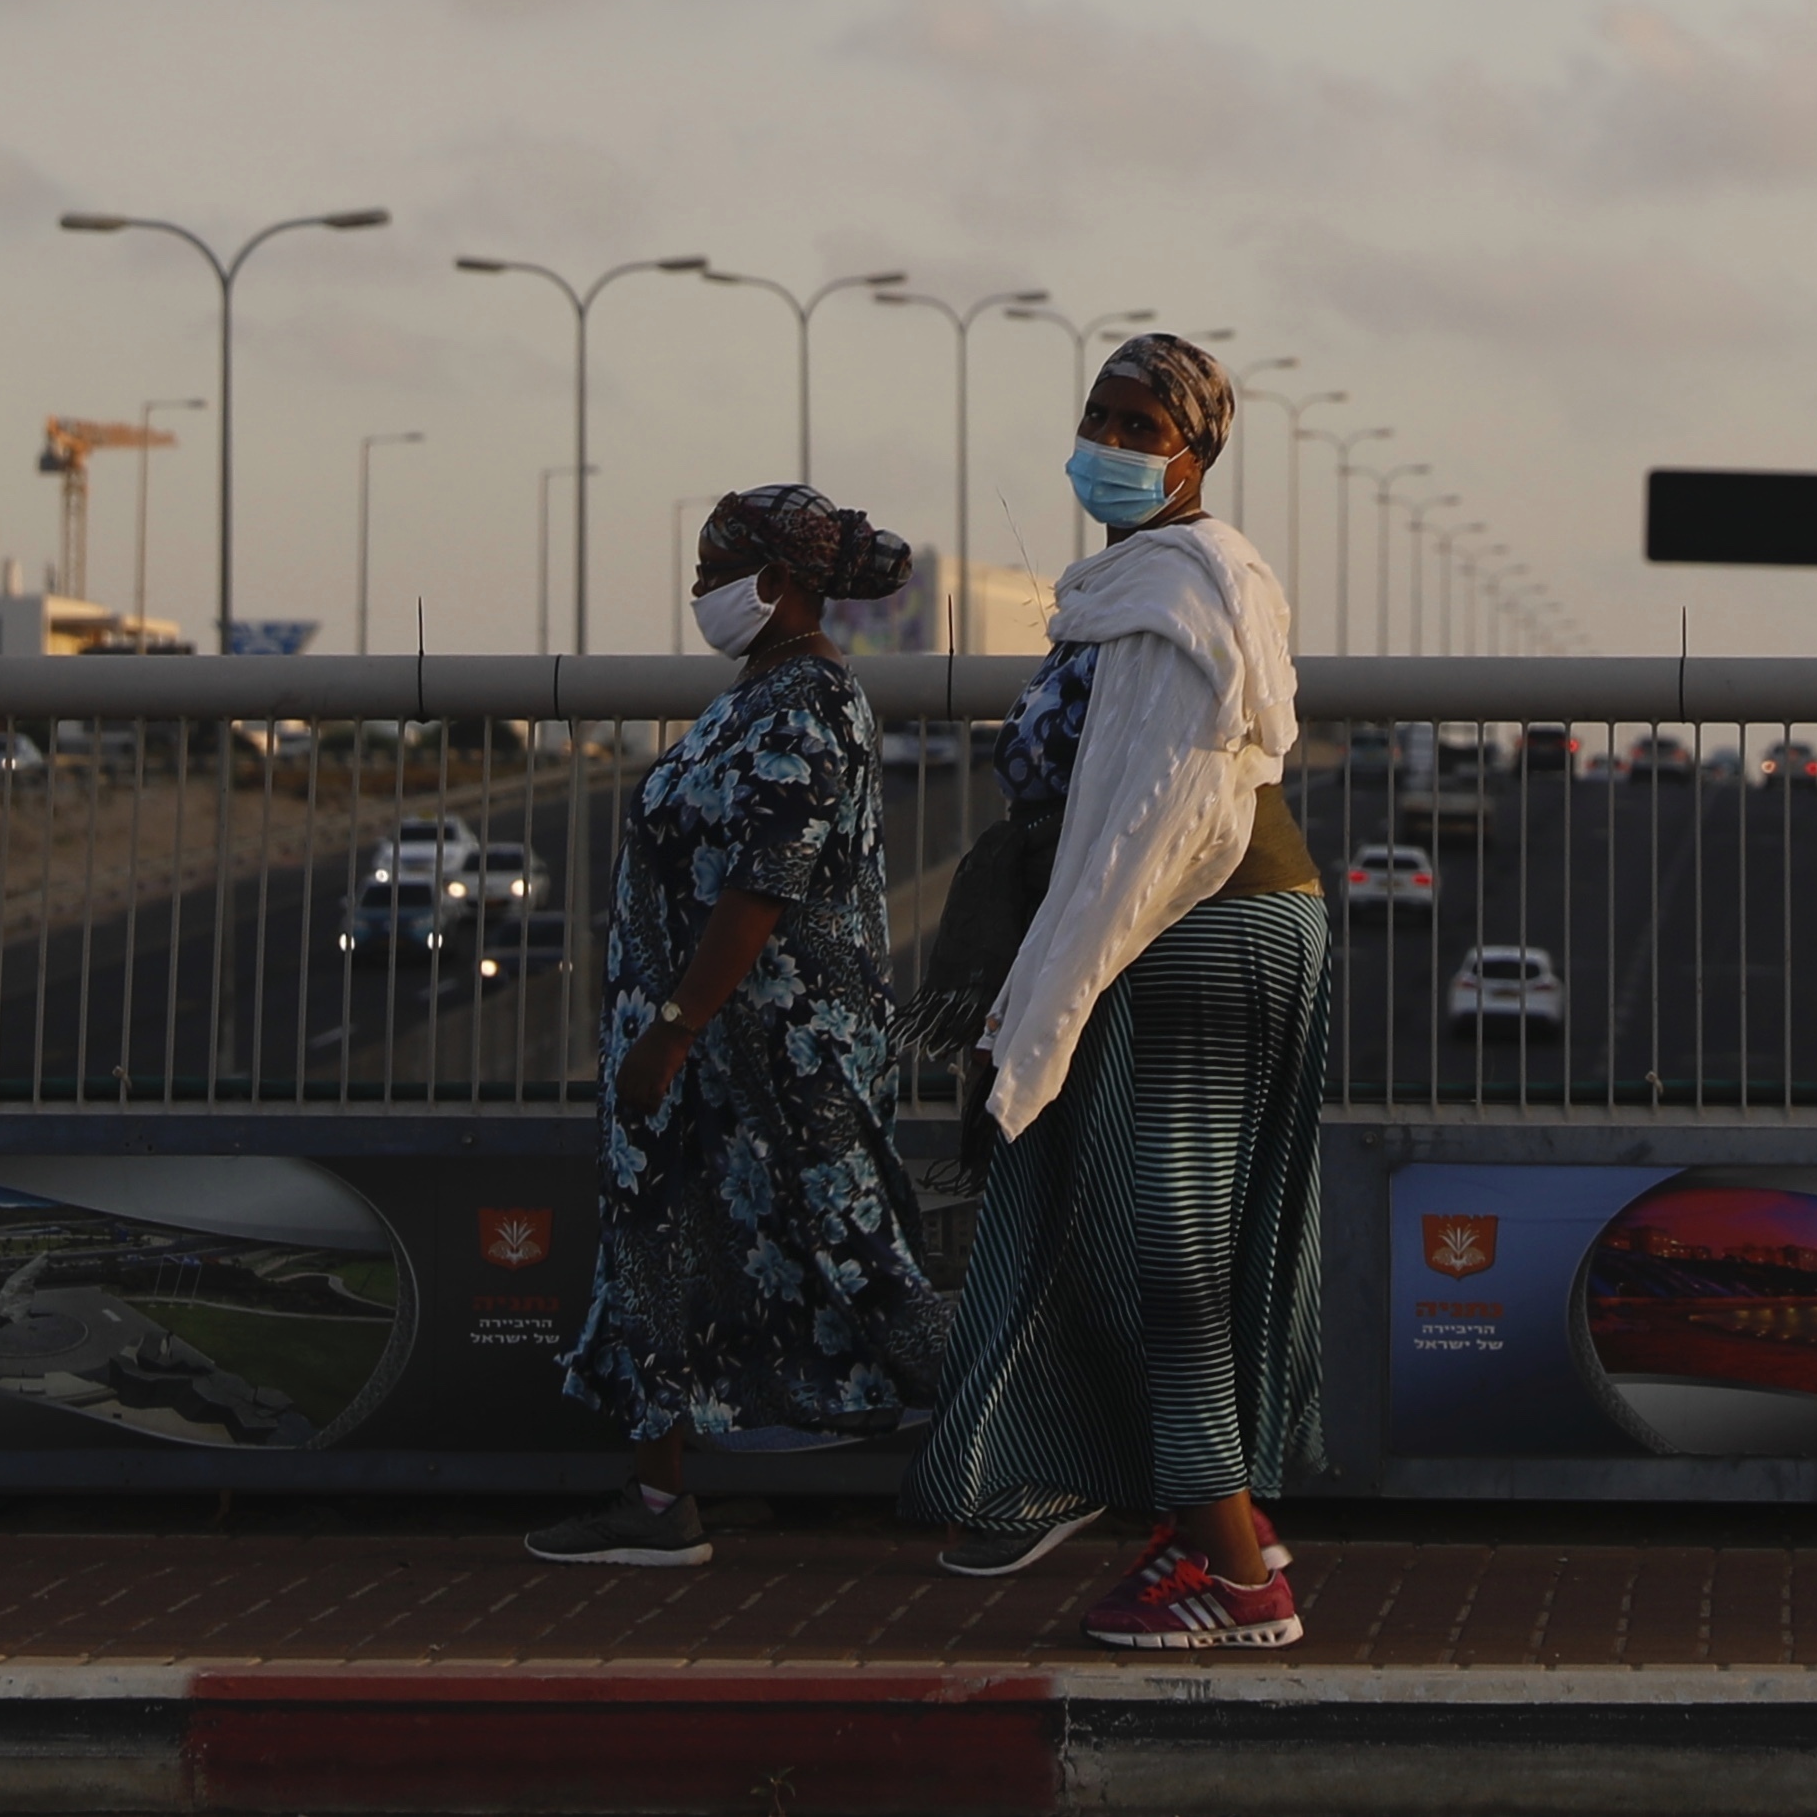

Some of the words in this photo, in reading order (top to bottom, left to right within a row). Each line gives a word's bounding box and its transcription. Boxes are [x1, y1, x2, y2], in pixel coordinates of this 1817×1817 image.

[472, 1295, 560, 1312] נתניה
[1416, 1301, 1504, 1318] נתניה
[479, 1318, 552, 1328] הריביירה
[1422, 1324, 1495, 1335] הריביירה
[470, 1332, 527, 1344] ישראל
[533, 1333, 560, 1344] של
[1414, 1339, 1470, 1350] ישראל
[1476, 1339, 1503, 1350] של
